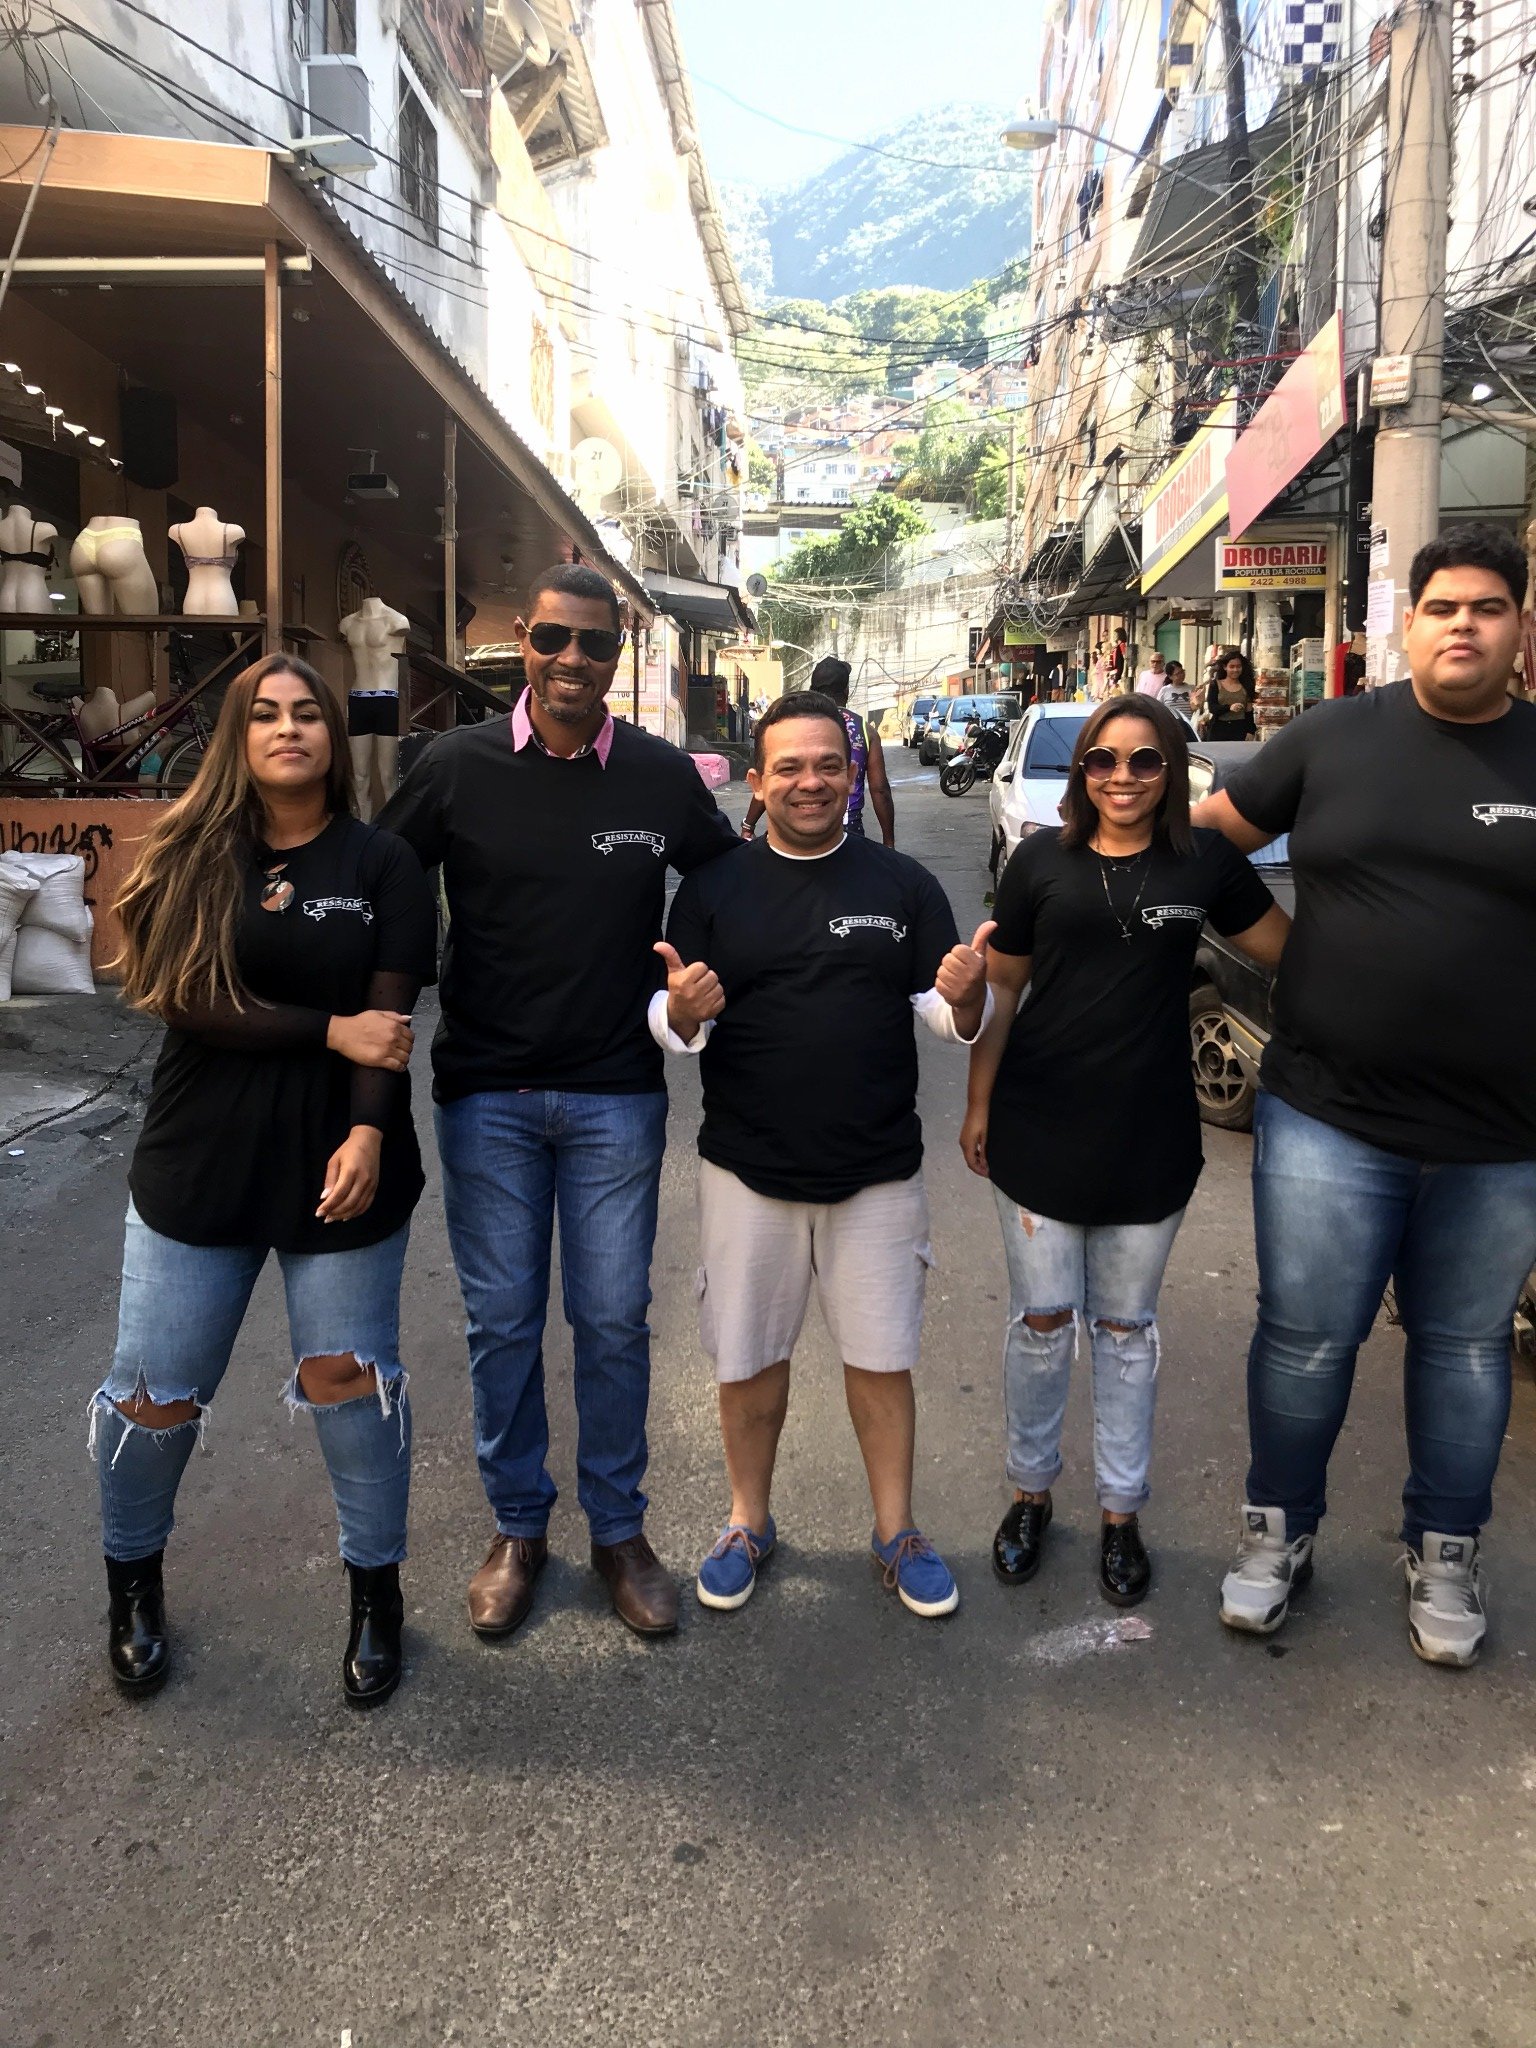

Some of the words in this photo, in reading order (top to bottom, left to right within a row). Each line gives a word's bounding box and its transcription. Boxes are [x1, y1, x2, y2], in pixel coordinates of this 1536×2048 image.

[1156, 441, 1211, 544] DROGARIA
[1234, 568, 1271, 576] POPULAR
[1285, 567, 1321, 575] ROCINHA
[1283, 577, 1307, 585] 4988
[1489, 807, 1536, 817] RESISTA
[605, 833, 657, 844] RESISTANCE
[842, 918, 898, 929] RESISTANCE
